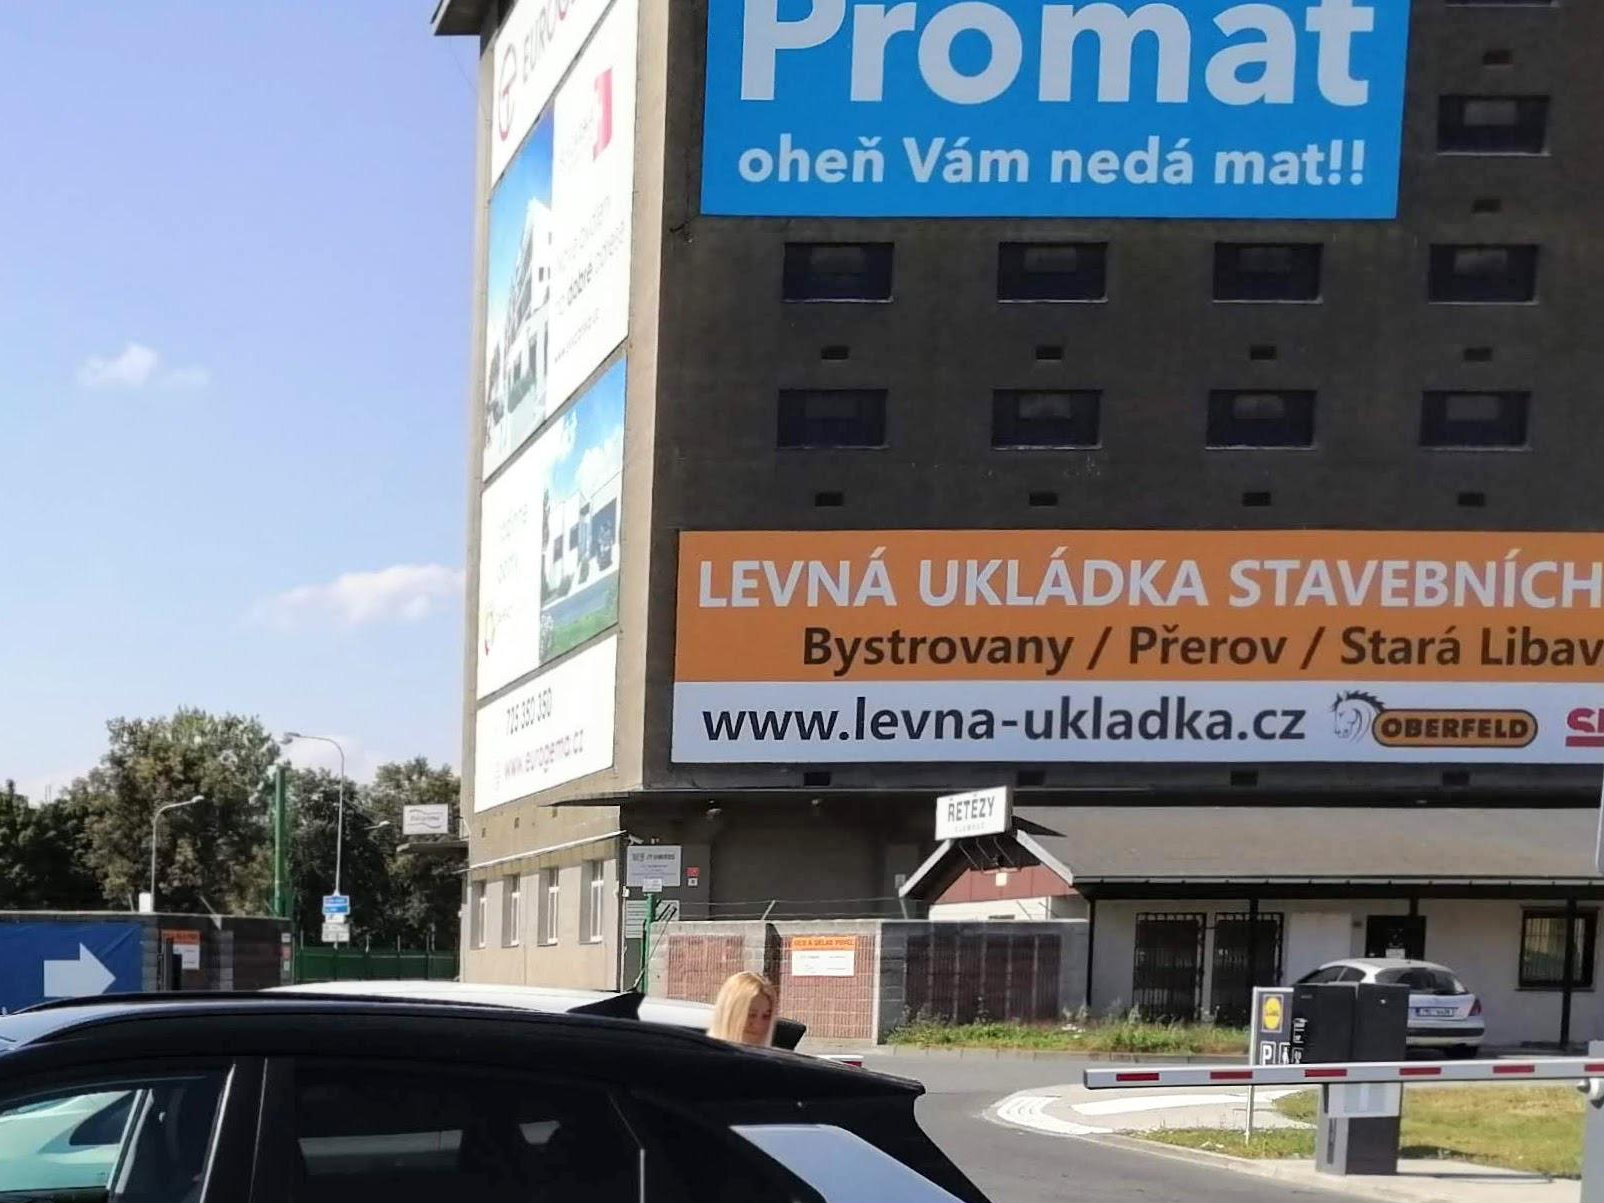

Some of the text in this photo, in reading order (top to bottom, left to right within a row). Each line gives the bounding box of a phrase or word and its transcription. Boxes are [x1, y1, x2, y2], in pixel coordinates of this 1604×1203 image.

[740, 0, 1375, 108] Promat
[738, 133, 1365, 185] oheň Vám nedá mat!!
[698, 547, 1604, 608] LEVNÁ UKLÁDKA STAVEBNÍCH
[803, 624, 1604, 676] Bystrovany / Přerov / Stará Libav
[702, 697, 1306, 741] www.levna-ukladka.cz
[1380, 717, 1529, 739] OBERFELD
